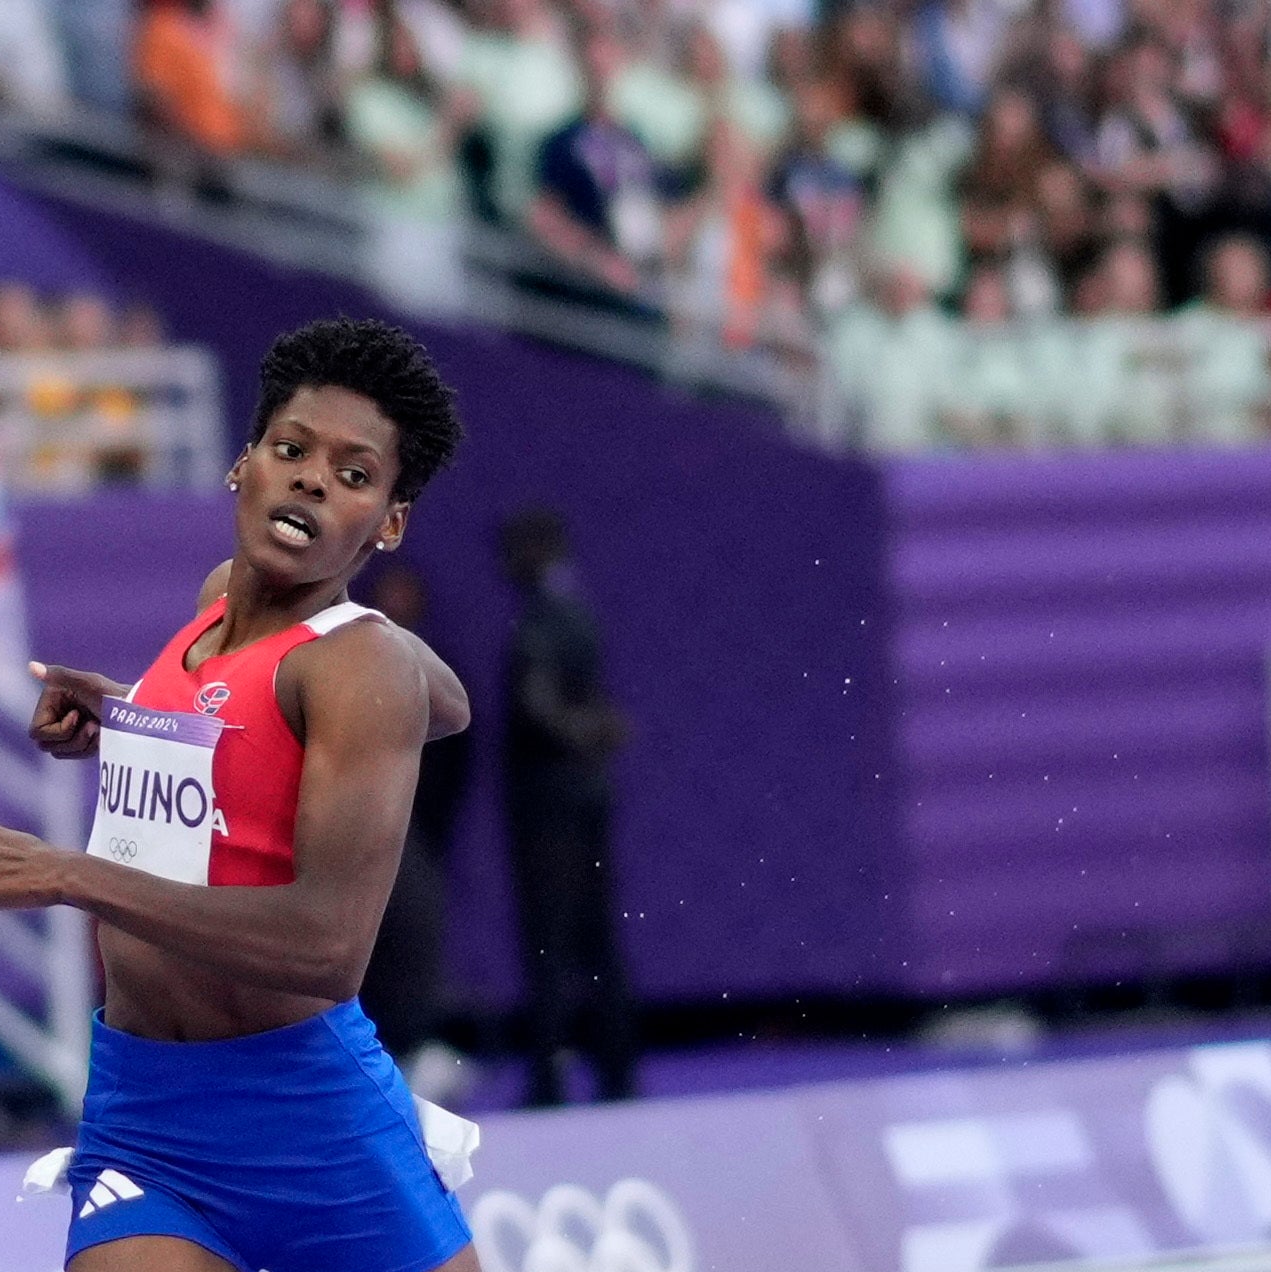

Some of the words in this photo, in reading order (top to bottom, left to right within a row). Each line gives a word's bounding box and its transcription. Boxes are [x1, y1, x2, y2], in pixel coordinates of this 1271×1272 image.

[110, 706, 149, 727] PARIS
[147, 717, 178, 732] 2024
[101, 761, 208, 828] AULINO
